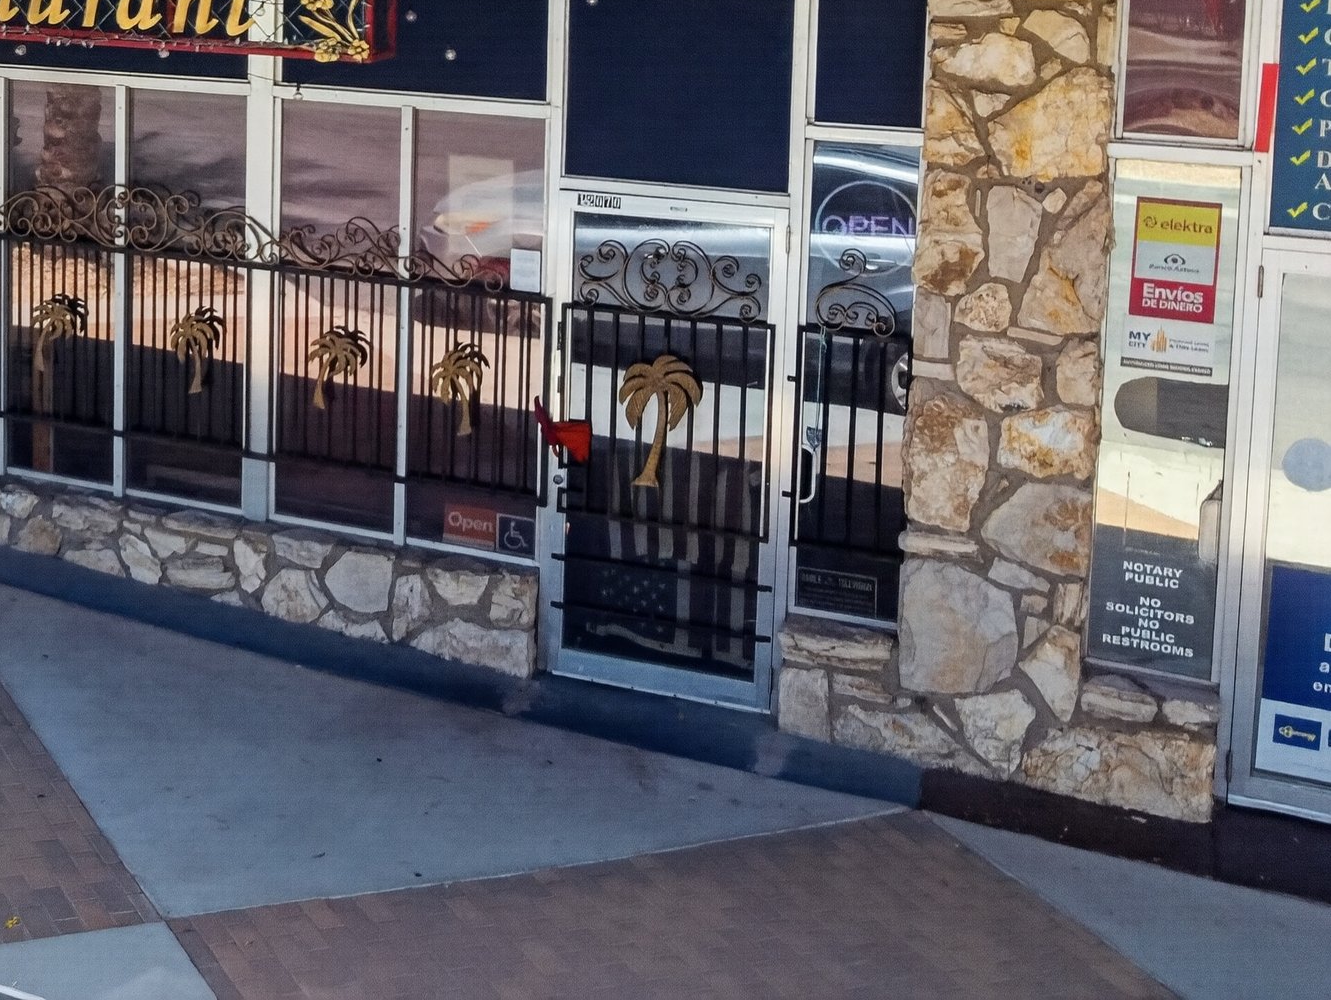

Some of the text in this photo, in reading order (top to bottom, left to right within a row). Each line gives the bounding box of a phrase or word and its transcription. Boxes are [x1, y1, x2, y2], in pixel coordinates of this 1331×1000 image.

[821, 214, 913, 237] OPEN
[1159, 217, 1213, 235] elektra
[1143, 282, 1204, 304] Envíos
[1142, 298, 1203, 313] DE DINERO
[1128, 330, 1151, 341] MY
[1128, 341, 1147, 349] CITY
[448, 511, 495, 533] Open
[1123, 560, 1183, 578] NOTARY
[1124, 571, 1179, 589] PUBLIC
[1139, 596, 1161, 608] NO
[1105, 601, 1195, 625] SOLICITORS
[1138, 618, 1160, 630] NO
[1121, 626, 1175, 643] PUBLIC
[1102, 633, 1194, 658] RESTROOMS
